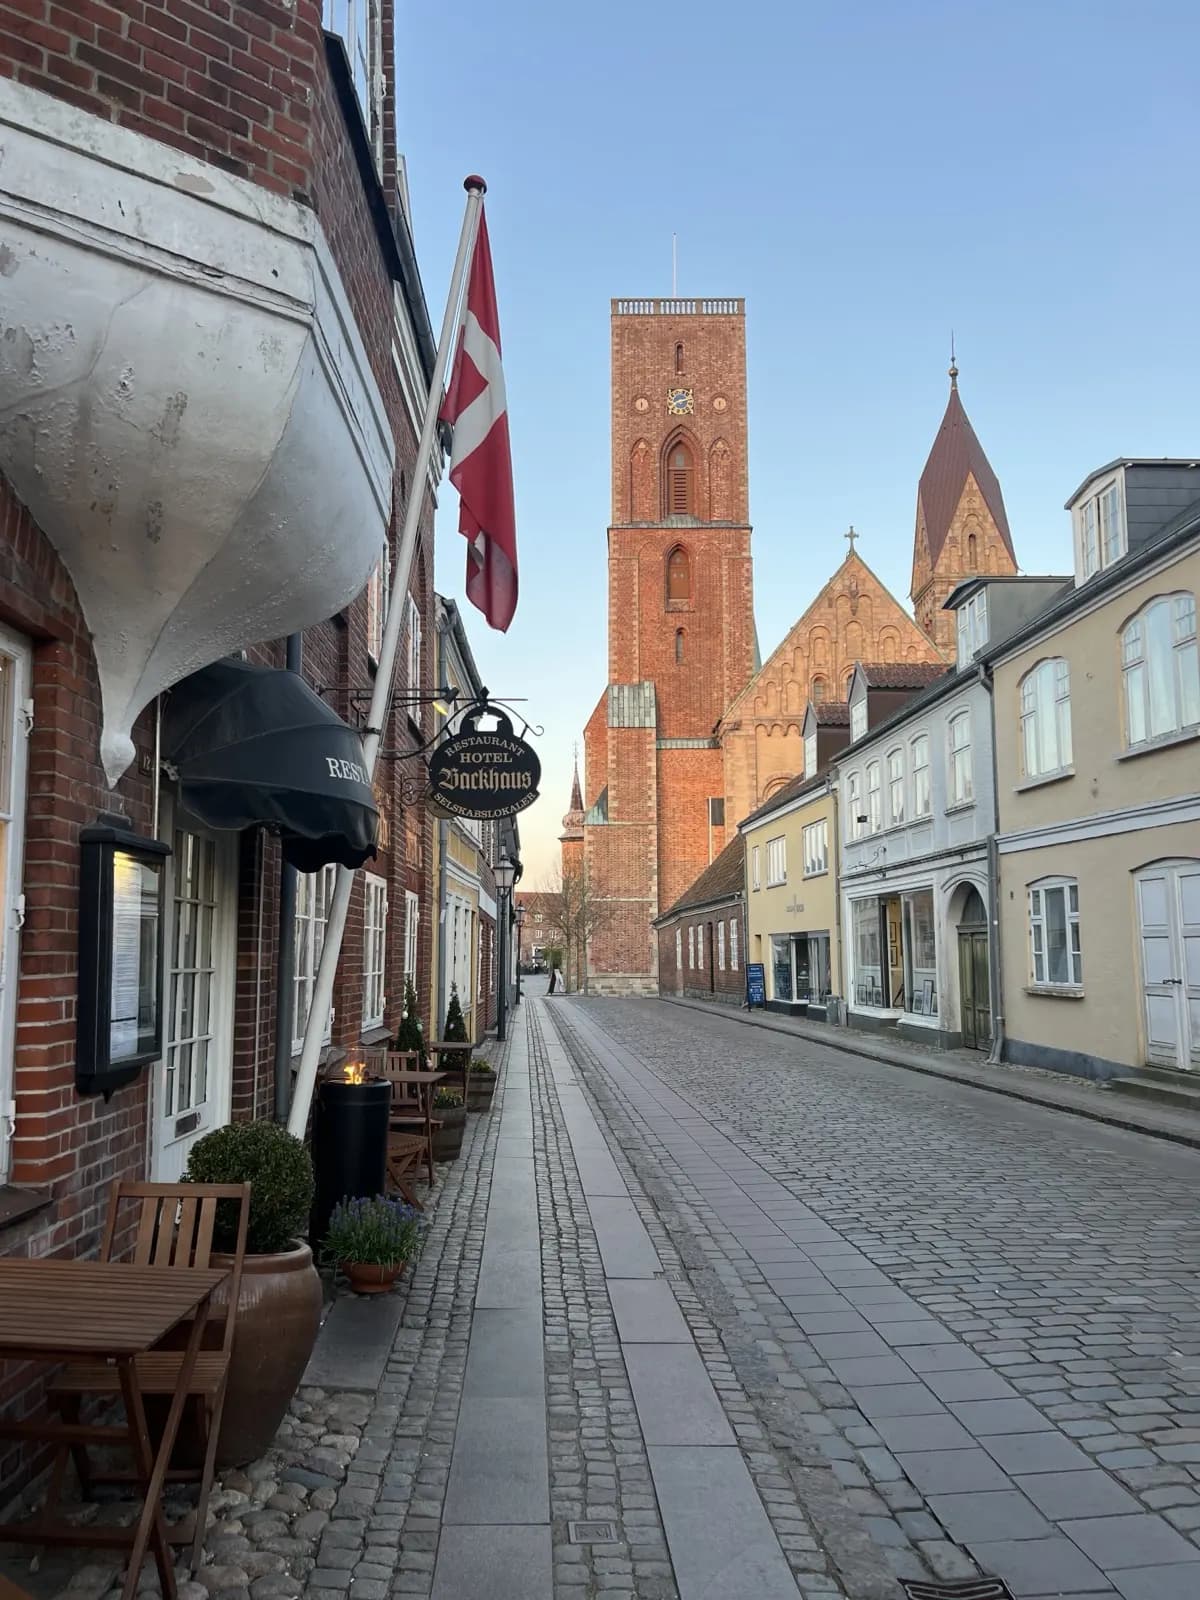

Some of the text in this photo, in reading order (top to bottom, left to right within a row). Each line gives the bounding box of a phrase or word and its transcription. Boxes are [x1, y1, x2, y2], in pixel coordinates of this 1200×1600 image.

[444, 736, 525, 757] RESTAURANT
[460, 752, 513, 764] HOTEL
[325, 757, 370, 787] REST
[438, 766, 532, 794] Backhaus
[433, 791, 537, 819] SELSKABSLOKALER
